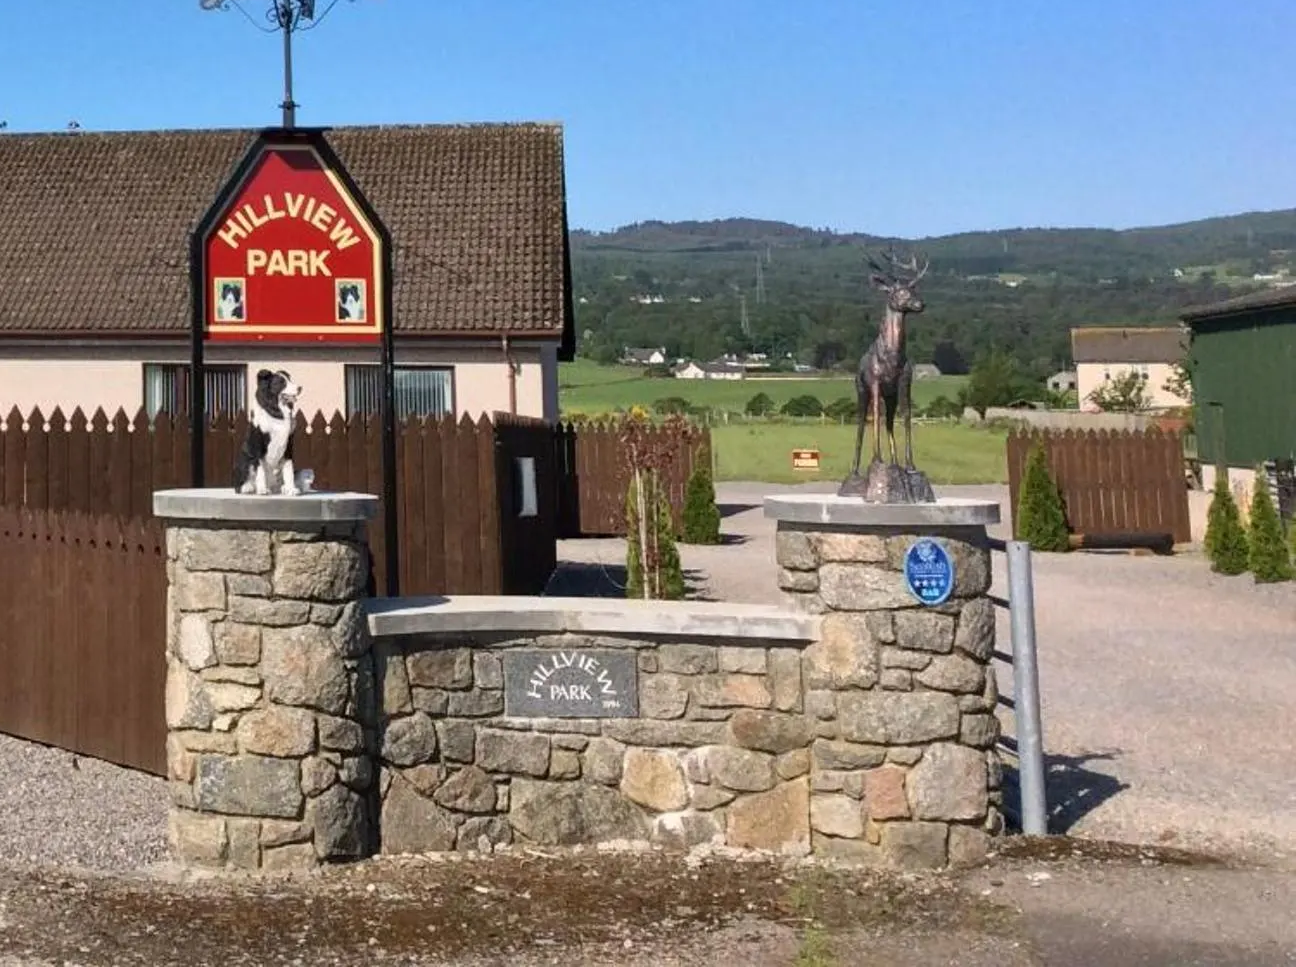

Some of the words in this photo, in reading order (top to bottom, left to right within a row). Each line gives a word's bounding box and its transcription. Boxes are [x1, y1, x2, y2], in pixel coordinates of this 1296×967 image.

[217, 192, 361, 250] HILLVIEW
[246, 249, 332, 276] PARK
[527, 651, 617, 699] HILLVIEW
[550, 684, 592, 700] PARK
